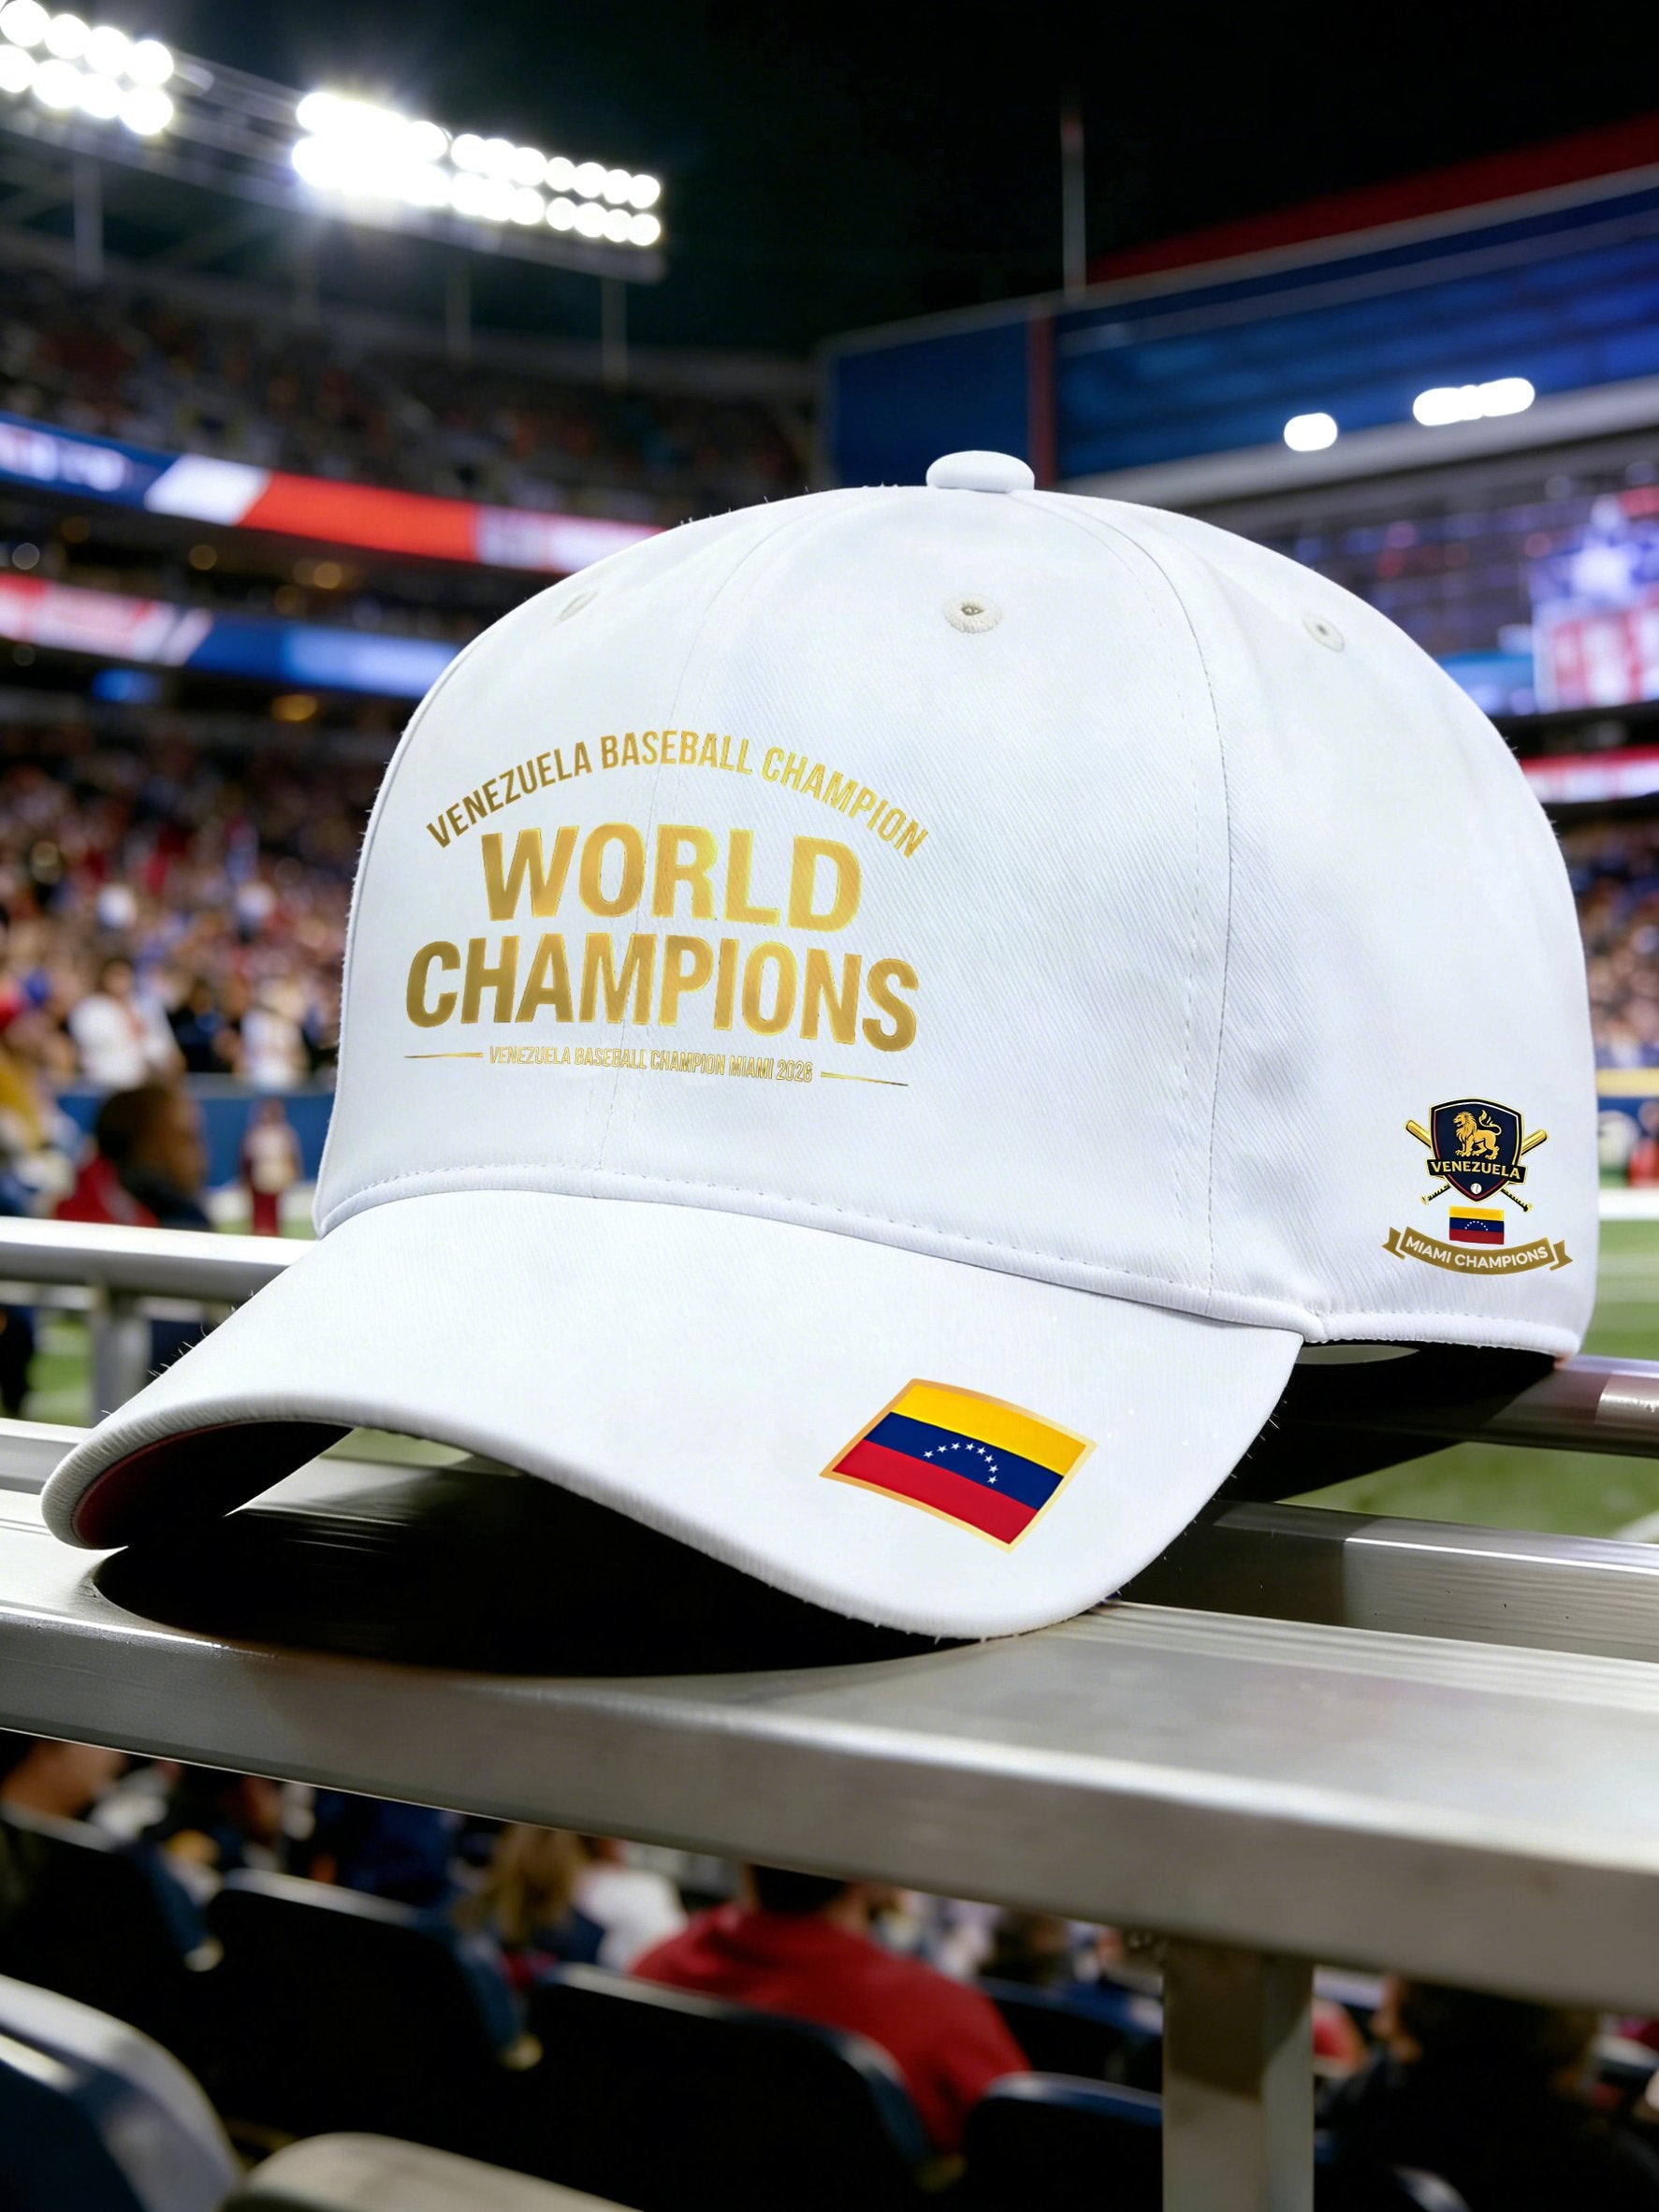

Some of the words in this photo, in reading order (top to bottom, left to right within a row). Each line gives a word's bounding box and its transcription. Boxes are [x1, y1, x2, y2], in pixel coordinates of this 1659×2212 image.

[427, 741, 592, 848] VENEZUELA
[600, 730, 752, 775] BASEBALL
[763, 746, 928, 858] CHAMPION
[481, 822, 862, 932] WORLD
[406, 932, 919, 1052] CHAMPIONS
[489, 1046, 572, 1065] VENEZUELA
[575, 1048, 648, 1070] BASEBALL
[650, 1050, 726, 1075] CHAMPION
[729, 1055, 774, 1079] MIAMI
[777, 1059, 814, 1083] 2026
[1430, 1160, 1521, 1180] VENEZUELA
[1405, 1236, 1451, 1264] MIAMI
[1455, 1246, 1549, 1269] CHAMPIONS
